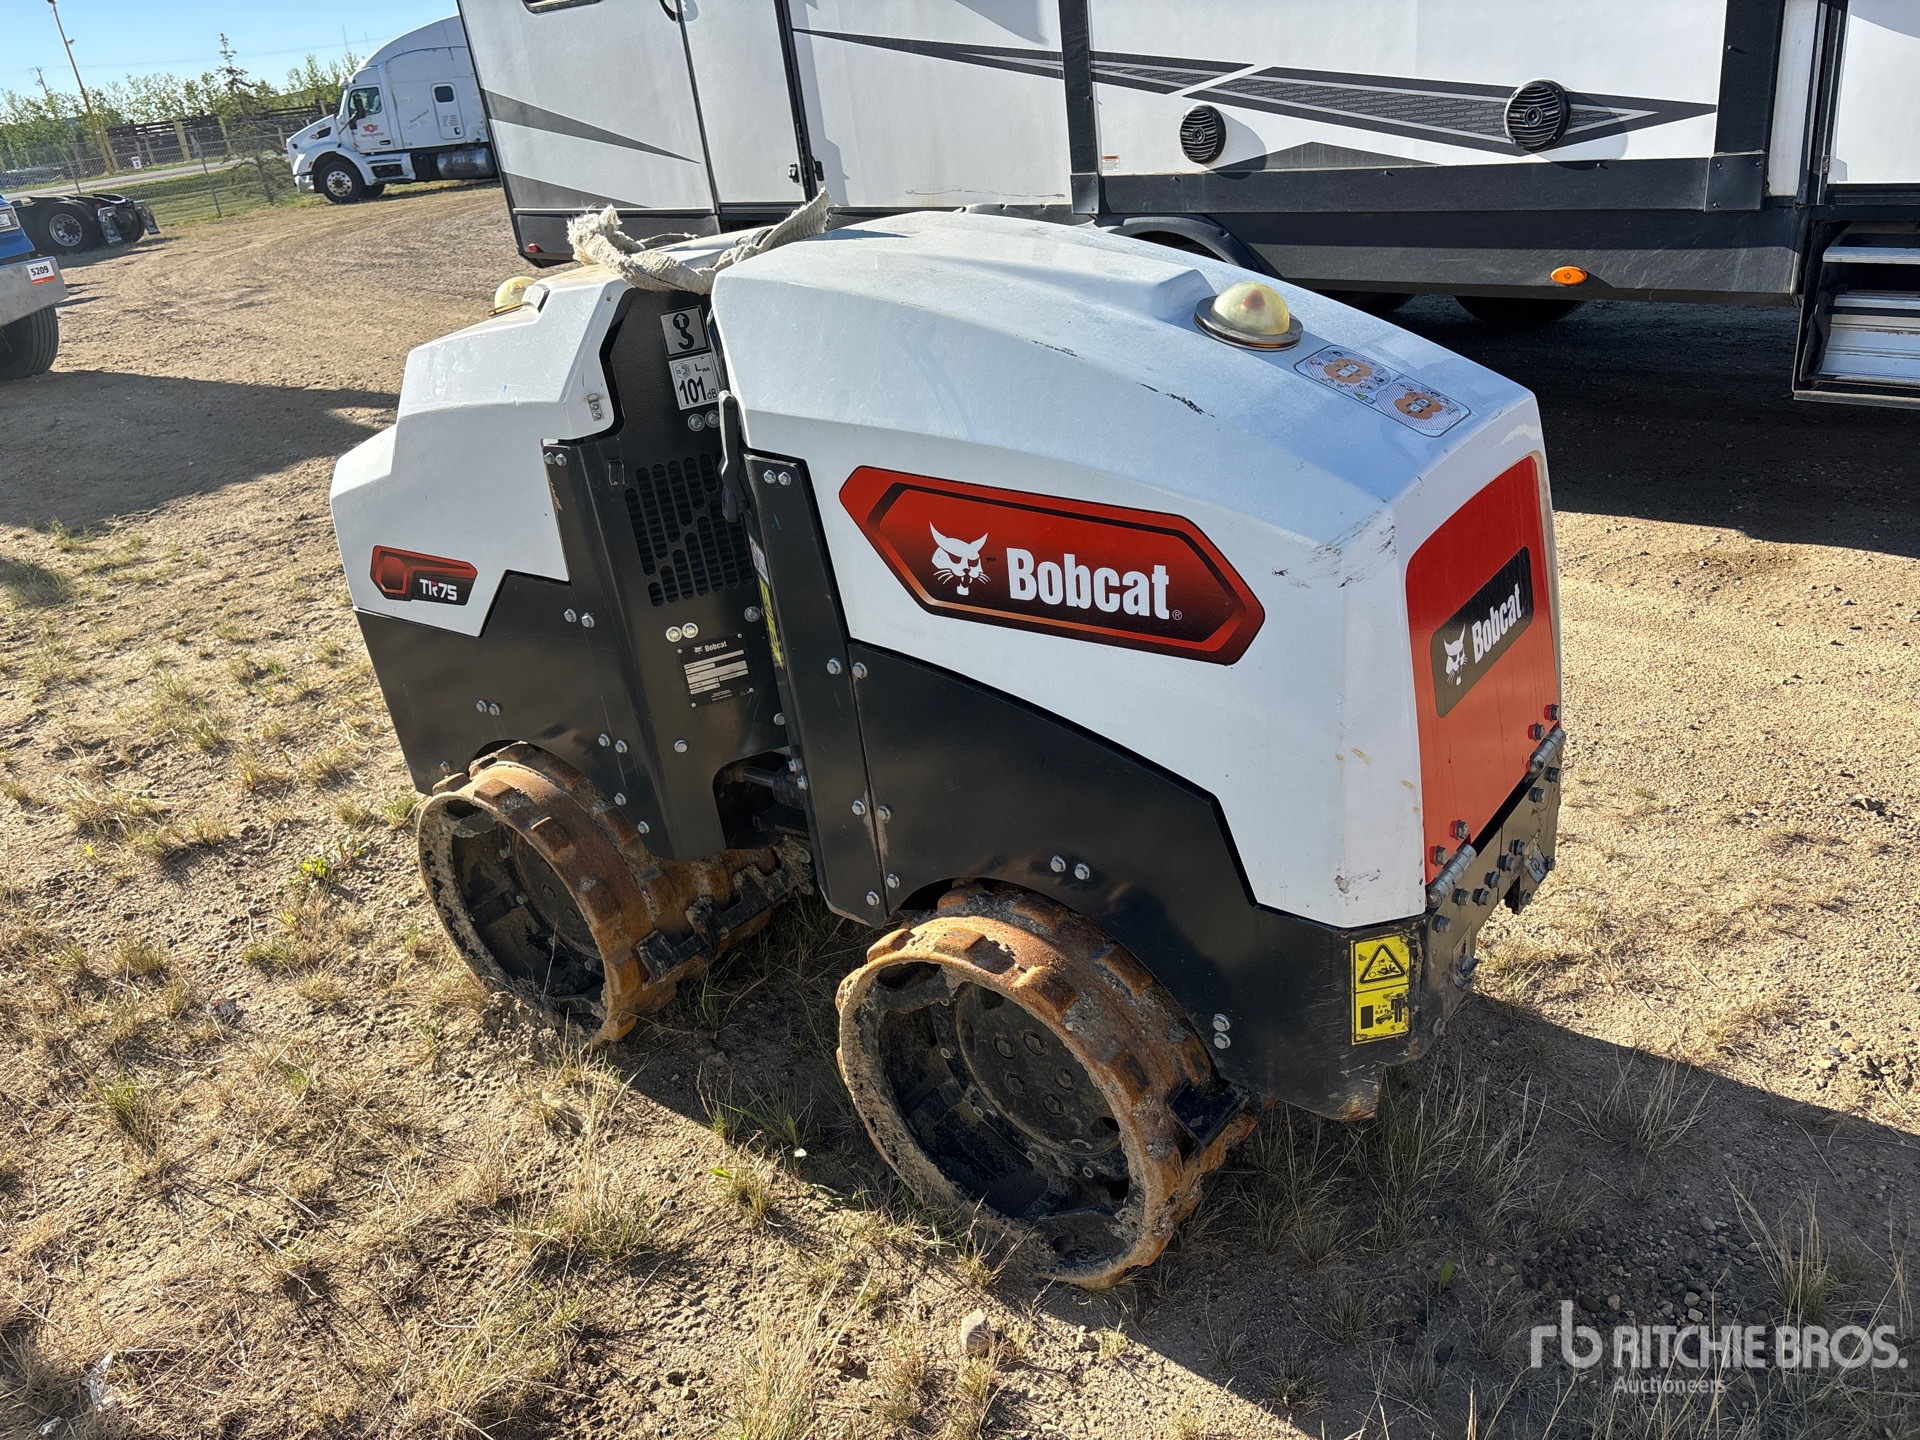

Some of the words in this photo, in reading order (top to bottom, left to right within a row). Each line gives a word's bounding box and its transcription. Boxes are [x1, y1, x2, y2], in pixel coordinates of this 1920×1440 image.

[30, 266, 49, 276] 5209
[679, 376, 707, 405] 101
[707, 388, 718, 399] dB
[419, 578, 458, 601] TR75
[1006, 547, 1170, 620] Bobcat
[1471, 582, 1523, 665] Bobcat
[704, 641, 727, 652] Bobcat
